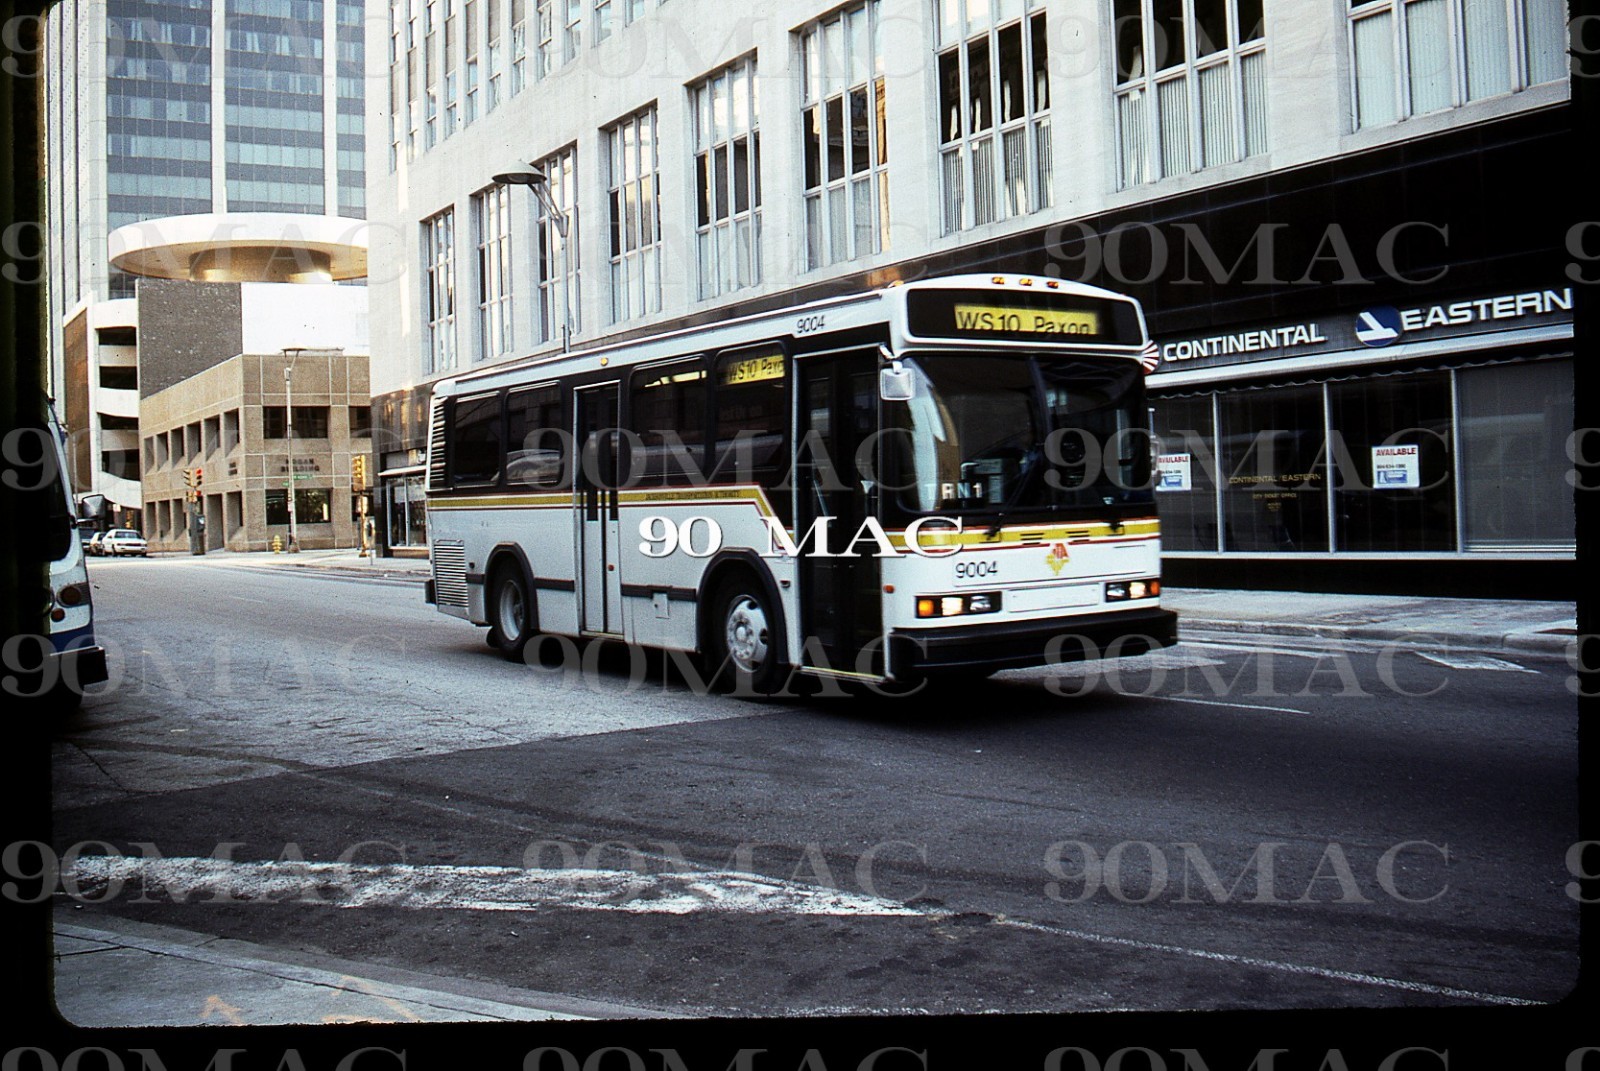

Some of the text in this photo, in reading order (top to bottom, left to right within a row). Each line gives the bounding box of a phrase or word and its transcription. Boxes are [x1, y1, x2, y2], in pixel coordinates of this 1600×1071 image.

[1402, 288, 1572, 331] EASTERN
[797, 315, 824, 333] 9004
[1033, 316, 1090, 334] Paxon
[1163, 323, 1325, 362] CONTINENTAL
[1376, 448, 1417, 456] AVAILABLE
[1228, 473, 1321, 484] CONTINENTAL EASTERN
[955, 560, 998, 579] 9004
